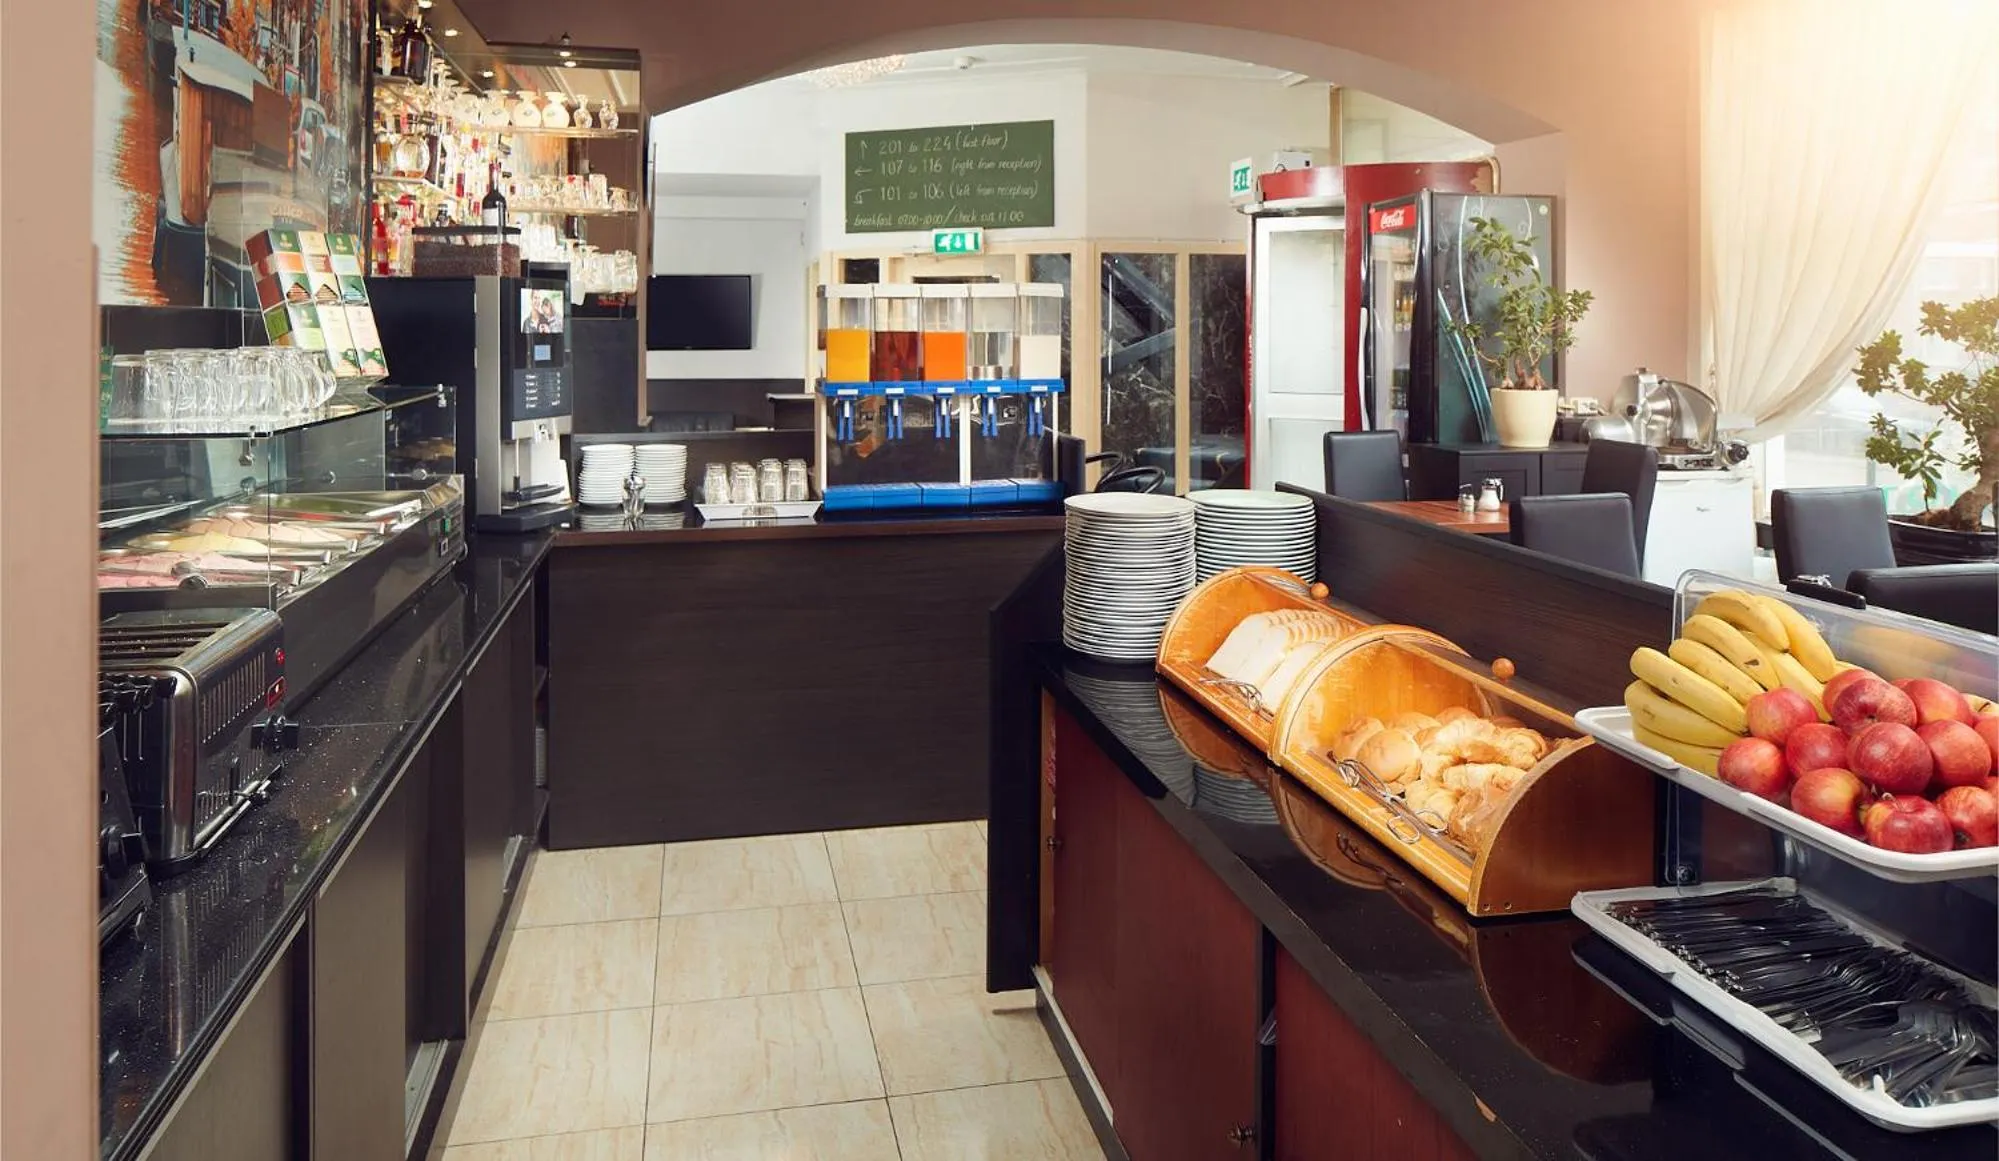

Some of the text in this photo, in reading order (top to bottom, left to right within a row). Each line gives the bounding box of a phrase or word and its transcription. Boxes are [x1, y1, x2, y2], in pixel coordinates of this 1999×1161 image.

[879, 140, 902, 155] 201
[908, 143, 918, 153] to
[923, 136, 951, 151] 224
[881, 159, 903, 176] 107
[908, 163, 917, 173] to
[923, 158, 943, 173] 116
[880, 186, 901, 201] 101
